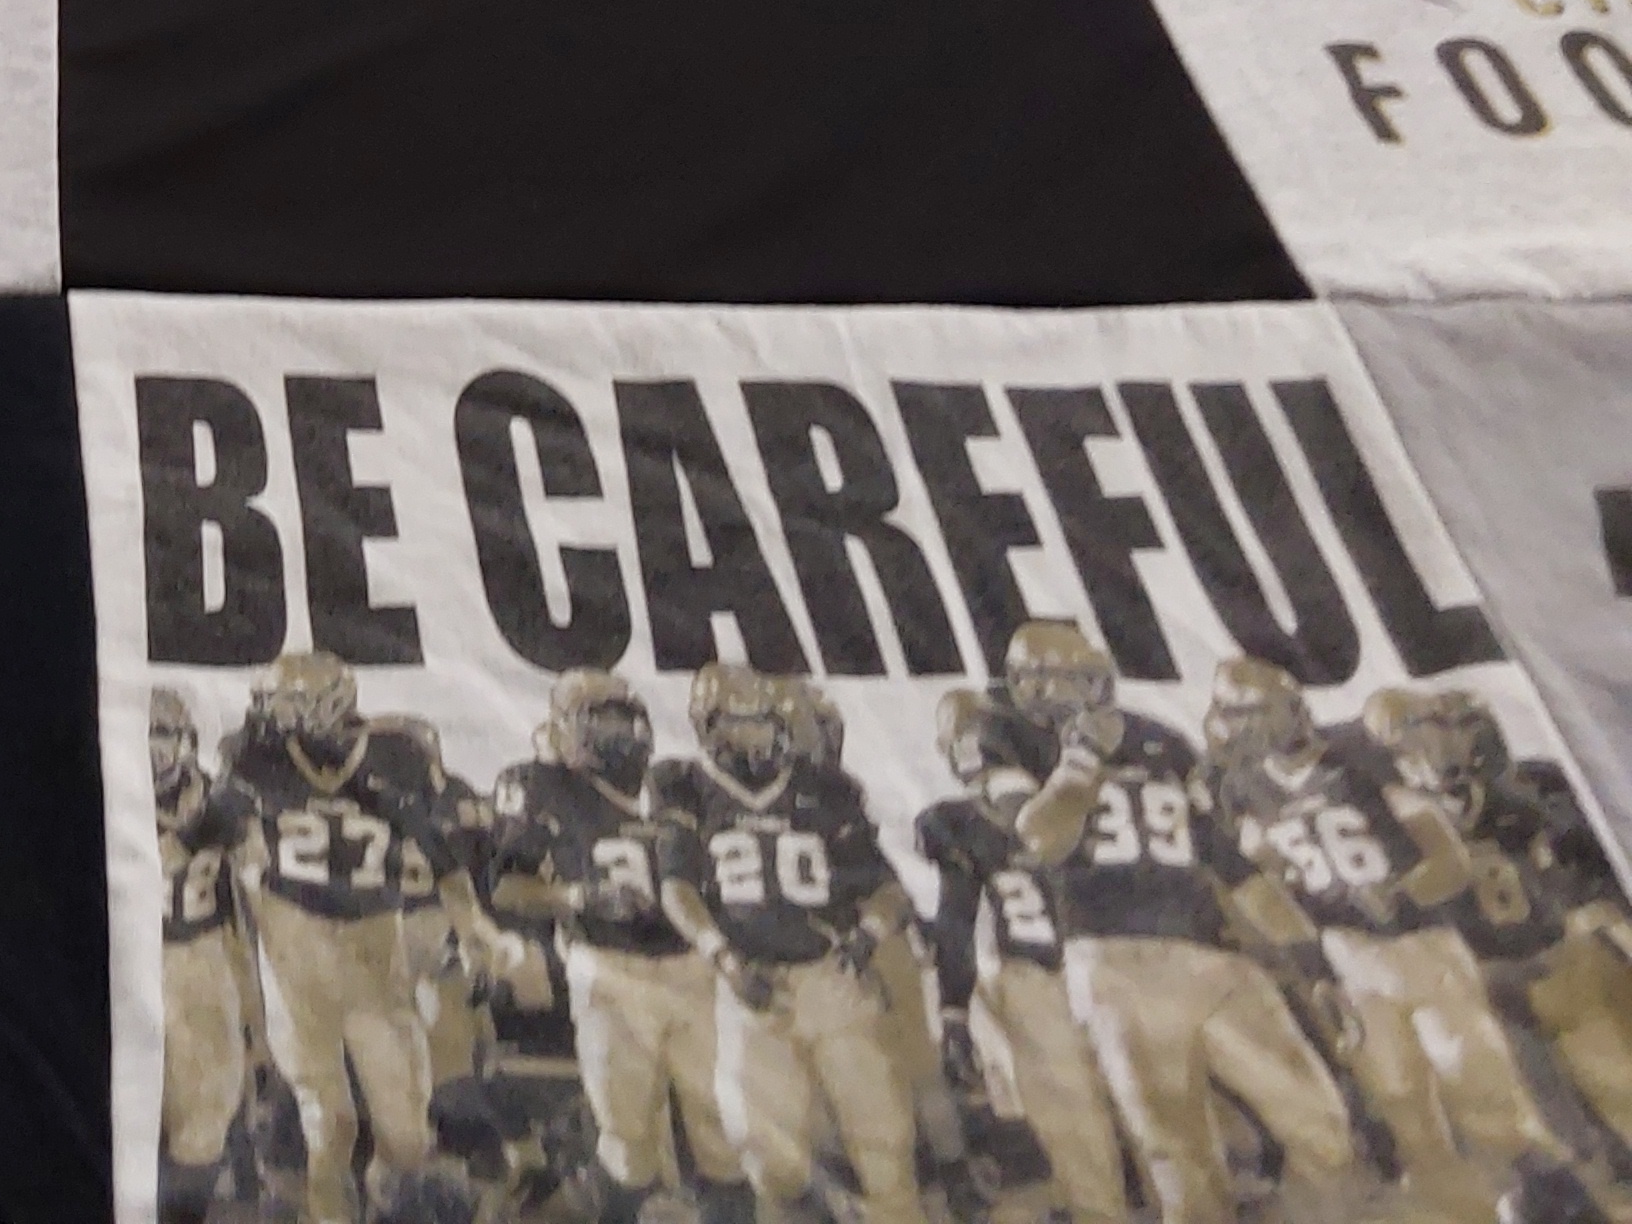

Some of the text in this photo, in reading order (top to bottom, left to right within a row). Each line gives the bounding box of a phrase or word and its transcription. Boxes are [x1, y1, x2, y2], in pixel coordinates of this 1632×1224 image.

[133, 366, 1518, 686] BE CAREFUL
[277, 810, 392, 890] 27
[708, 832, 830, 906] 20
